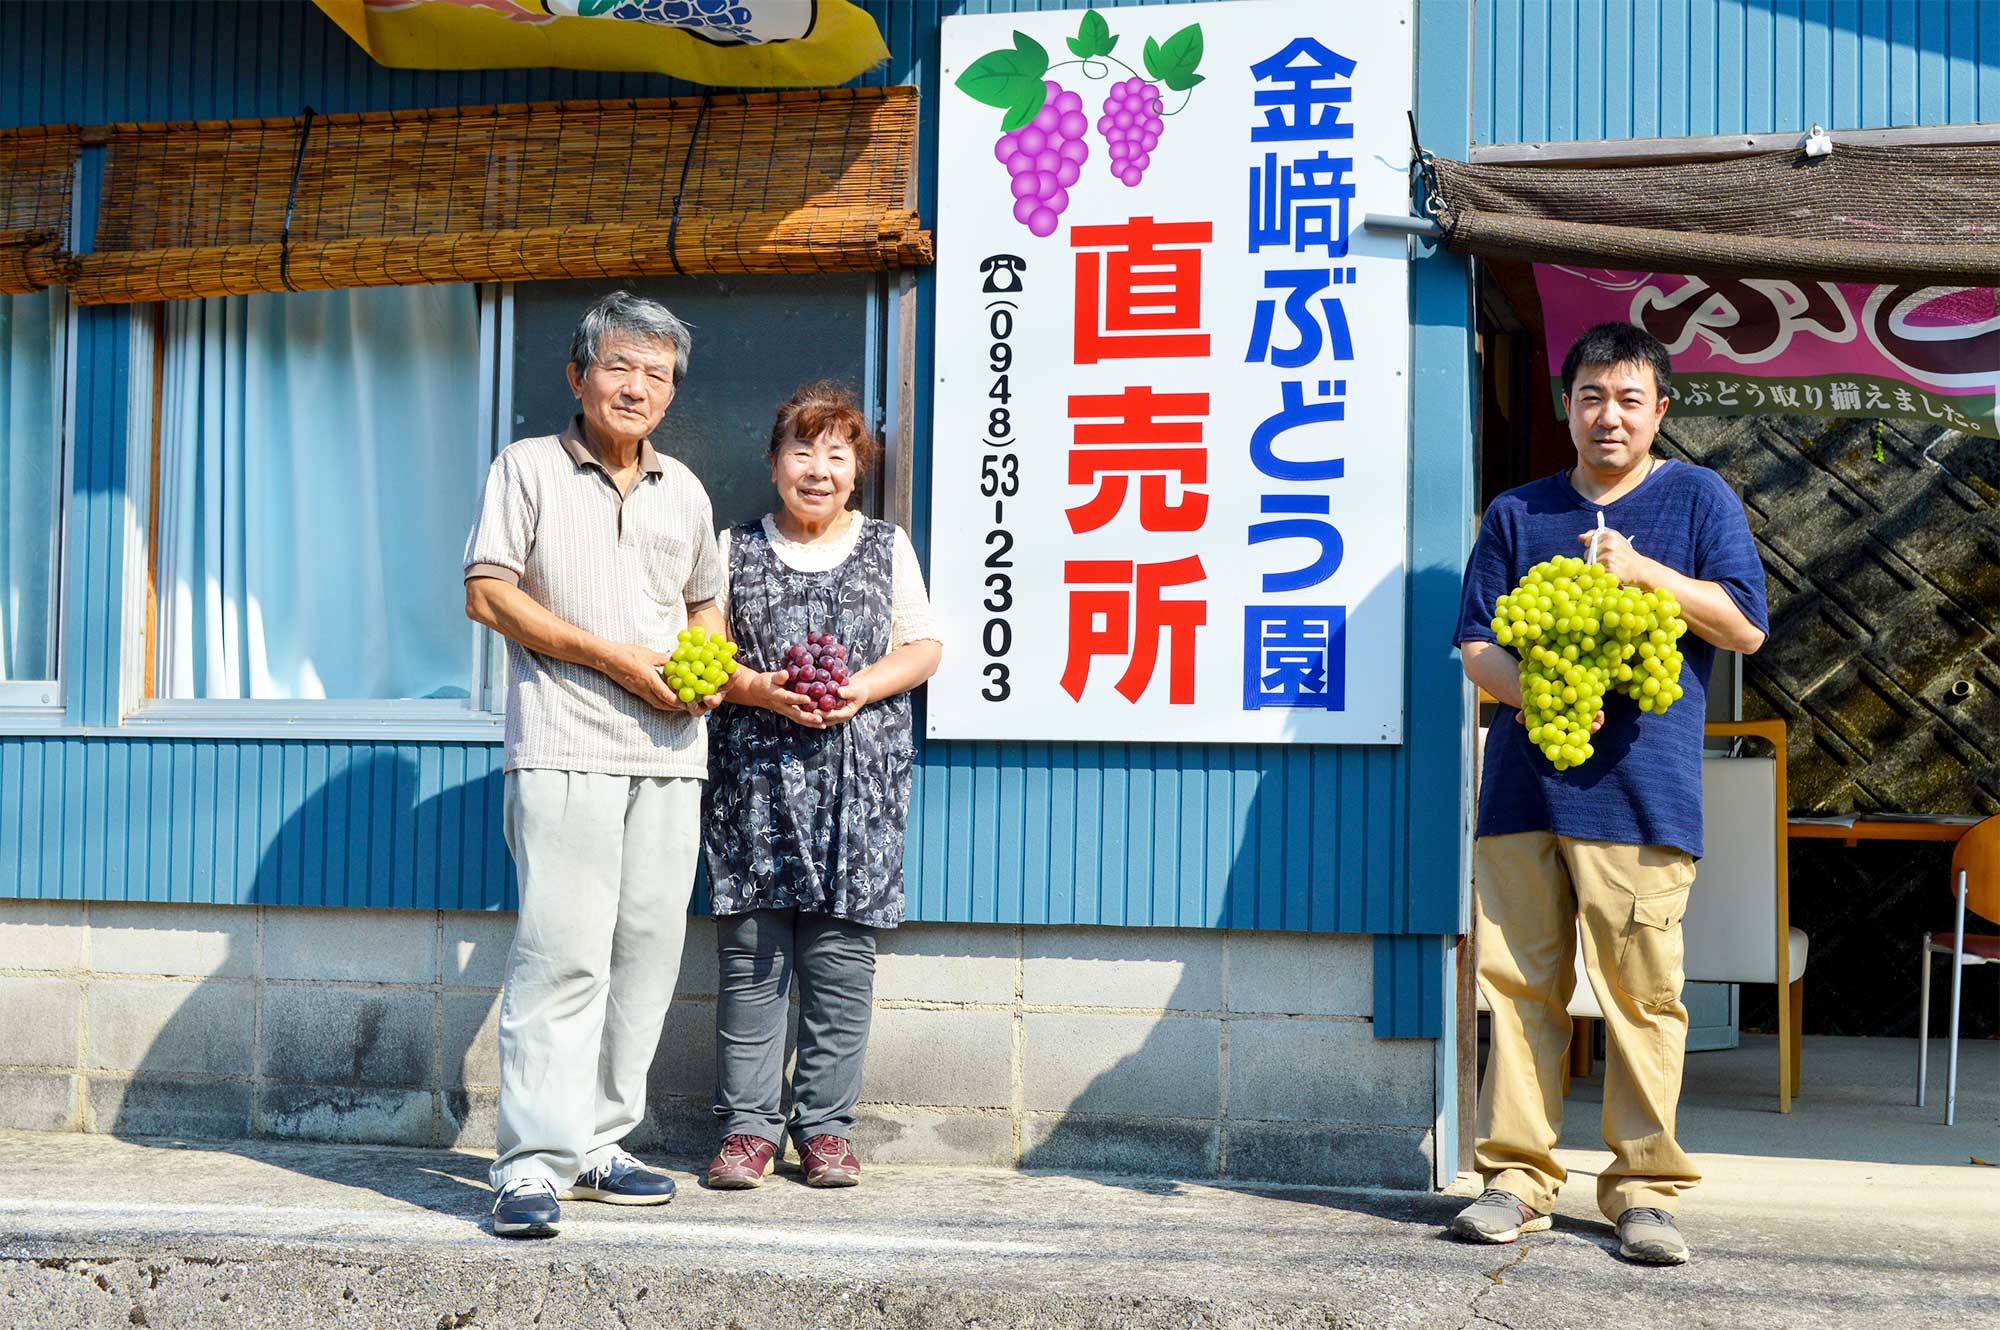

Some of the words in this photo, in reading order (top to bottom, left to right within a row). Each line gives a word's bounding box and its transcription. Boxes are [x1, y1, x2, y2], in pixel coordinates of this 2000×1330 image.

[980, 300, 1020, 703] (0948)53-2303
[1060, 216, 1213, 706] 直売所
